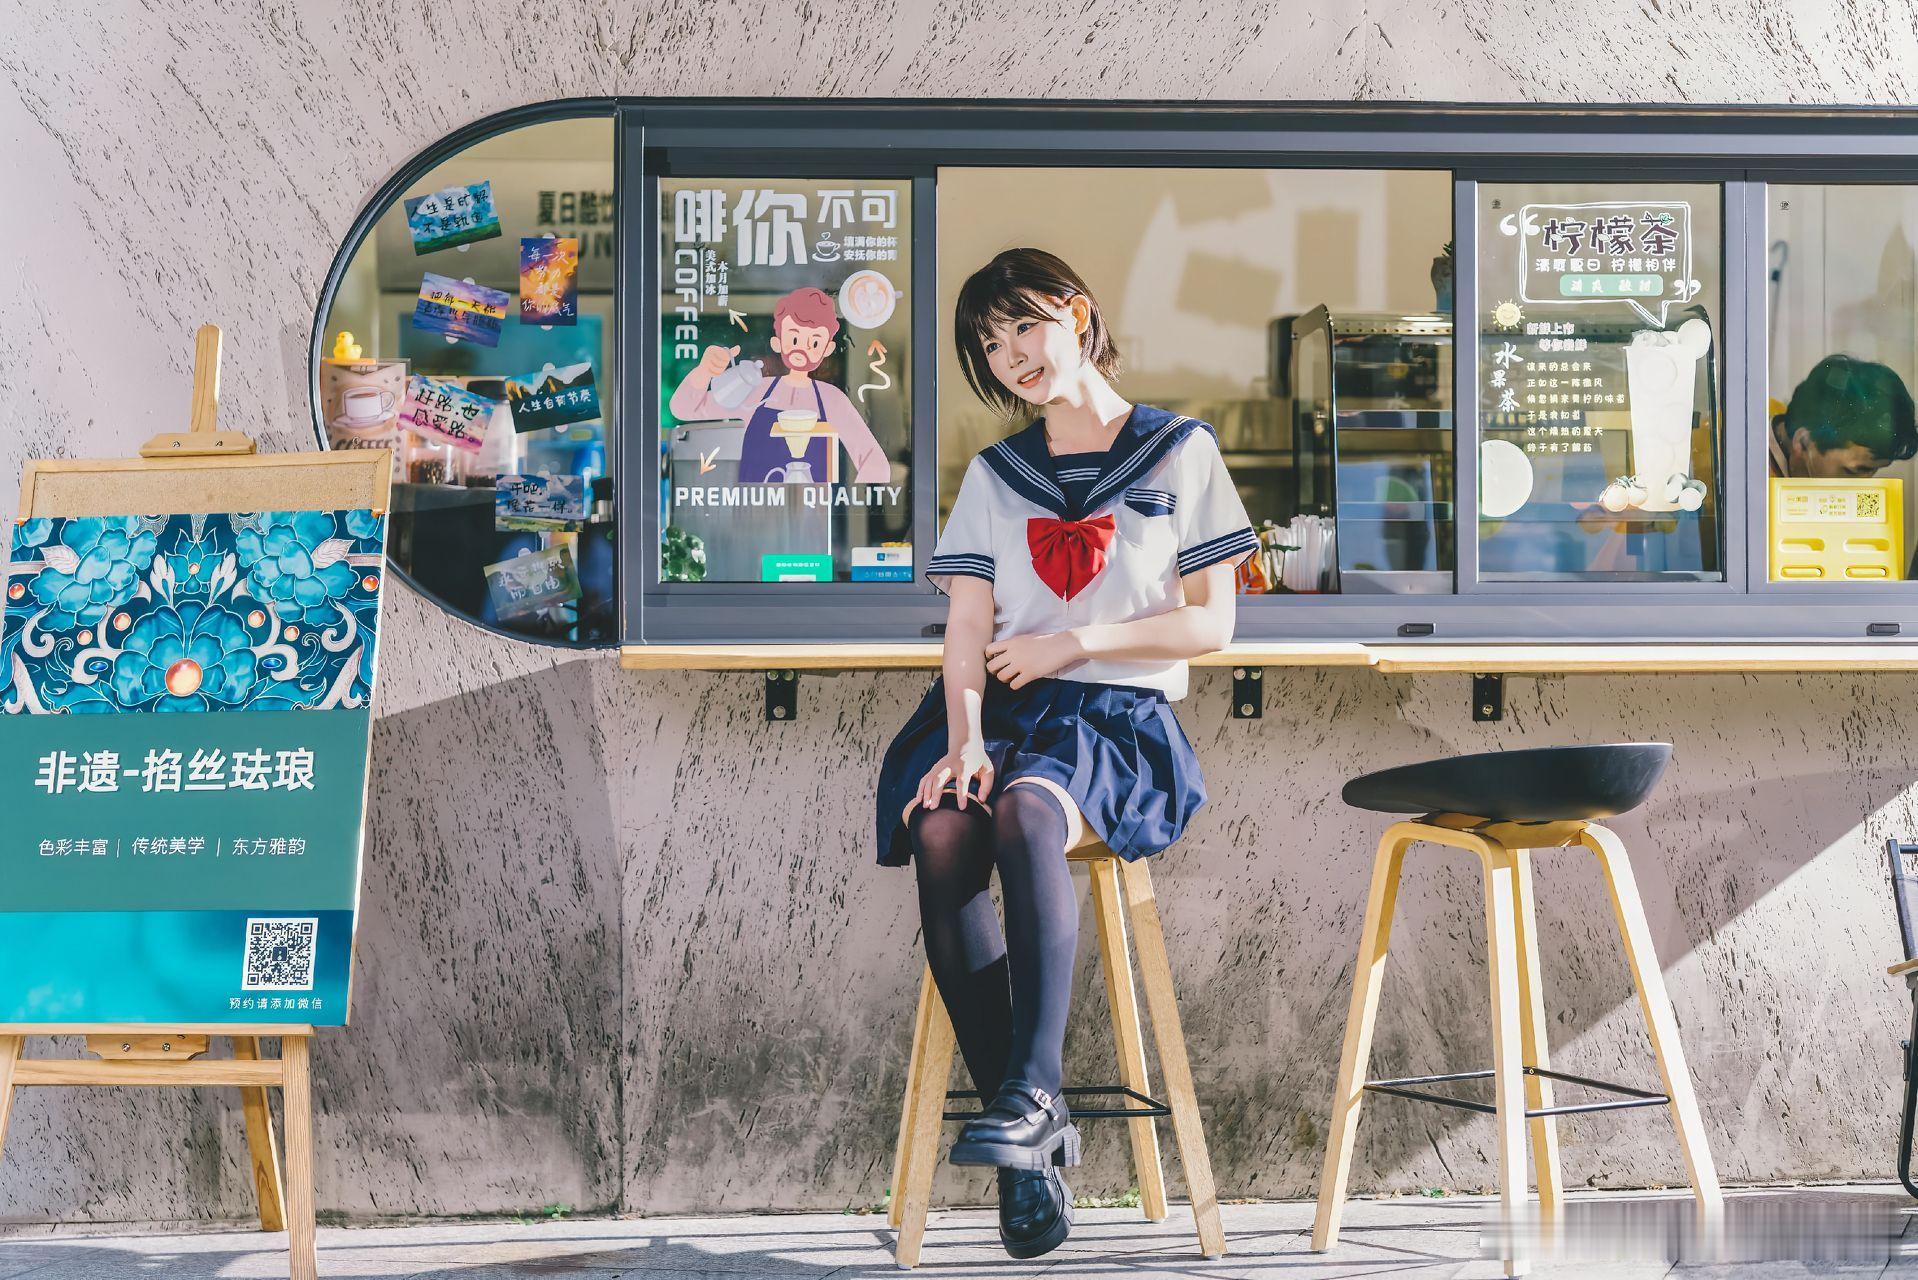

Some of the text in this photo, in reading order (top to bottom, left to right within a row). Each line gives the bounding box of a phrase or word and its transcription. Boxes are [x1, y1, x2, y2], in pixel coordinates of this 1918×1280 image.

[1543, 211, 1679, 255] 柠檬茶
[528, 246, 569, 265] 每一次
[705, 249, 717, 296] 美式加冰
[1611, 258, 1677, 273] 柠檬相伴
[675, 249, 699, 360] COFFEE
[1526, 322, 1575, 336] 新鲜上市
[1526, 361, 1592, 372] 该来的总会来
[1490, 341, 1524, 413] 水果茶
[1526, 377, 1603, 388] 正如这一阵微风
[518, 388, 592, 413] 人生自有节奏
[1527, 409, 1581, 420] 于是我知道
[1526, 442, 1592, 453] 终于有了解药
[675, 486, 902, 508] PREMIUM QUALITY
[34, 747, 316, 794] 非遗-掐丝珐琅
[38, 837, 306, 857] 色彩丰富 传统美学 东方雅韵
[229, 997, 323, 1010] 预约请添加微信
